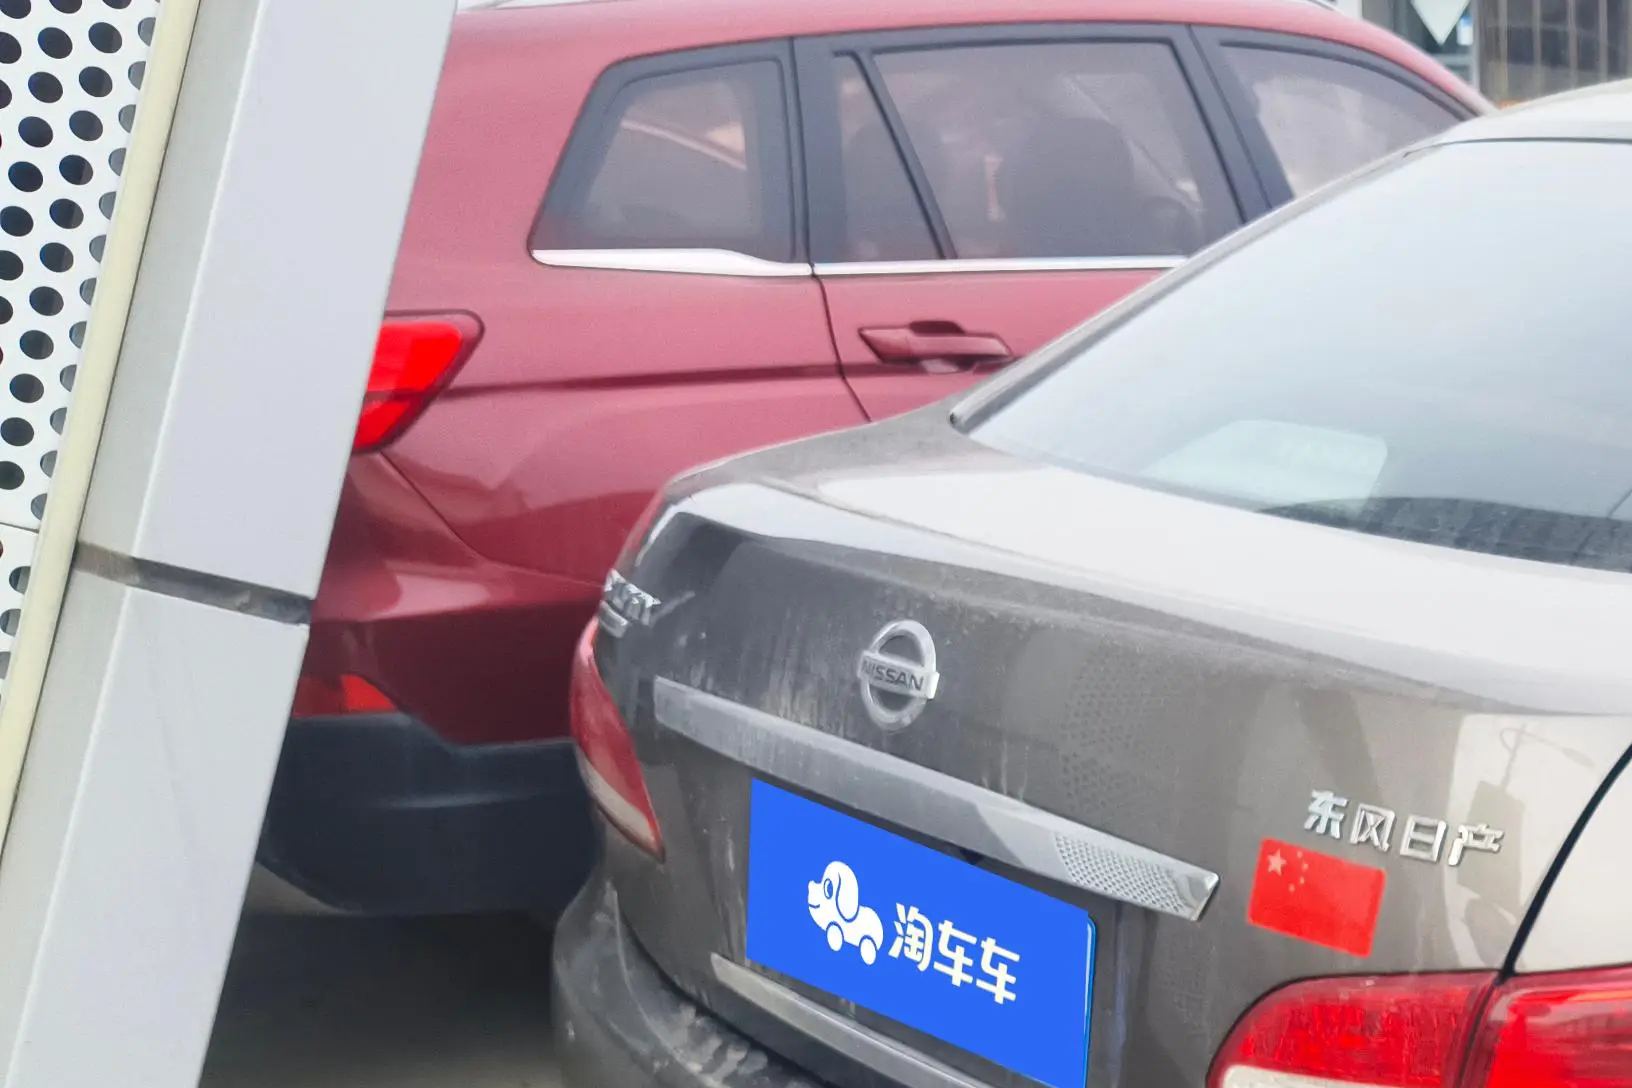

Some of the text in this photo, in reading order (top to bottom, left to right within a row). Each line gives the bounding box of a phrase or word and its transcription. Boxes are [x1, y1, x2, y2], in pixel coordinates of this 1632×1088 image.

[861, 657, 925, 692] NISSAN
[1304, 789, 1504, 867] 东风日产
